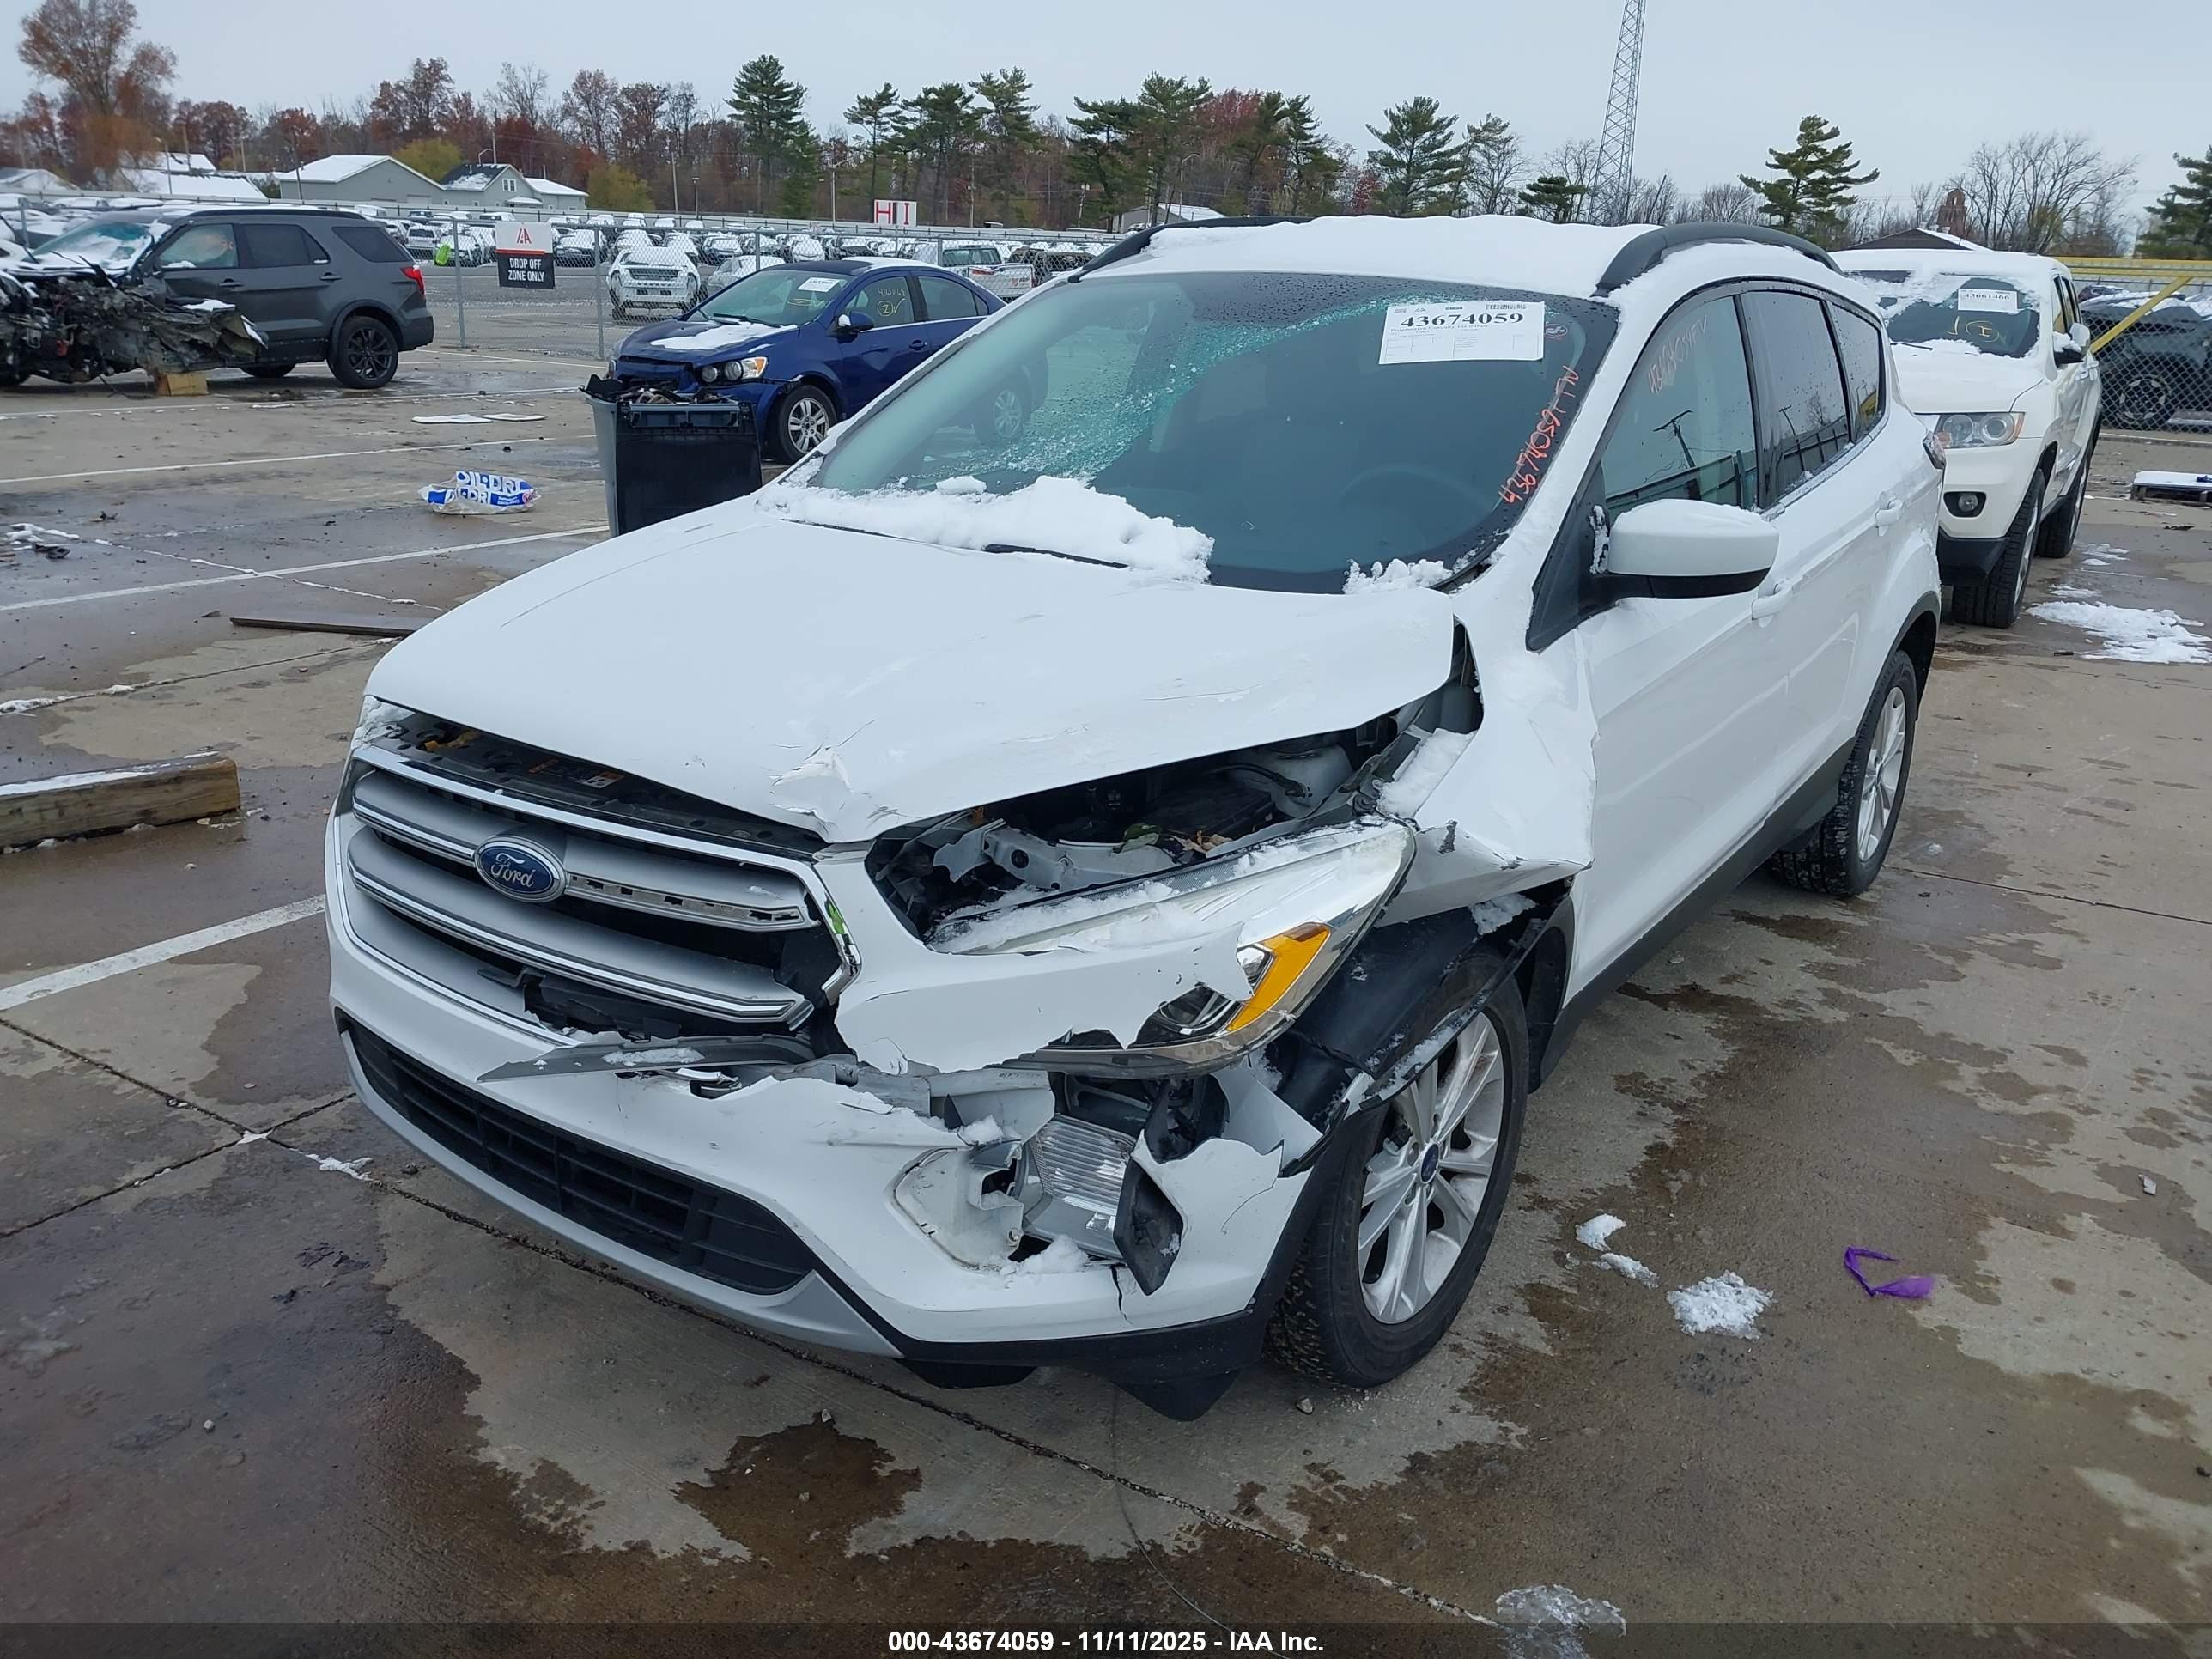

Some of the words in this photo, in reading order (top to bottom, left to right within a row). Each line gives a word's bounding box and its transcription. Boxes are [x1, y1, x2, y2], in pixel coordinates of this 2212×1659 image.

[876, 201, 910, 225] HI
[509, 258, 528, 269] DROP
[529, 259, 542, 270] OFF
[508, 270, 526, 282] ZONE
[527, 271, 544, 283] ONLY
[1401, 313, 1524, 327] 43674059
[490, 853, 536, 887] Ford
